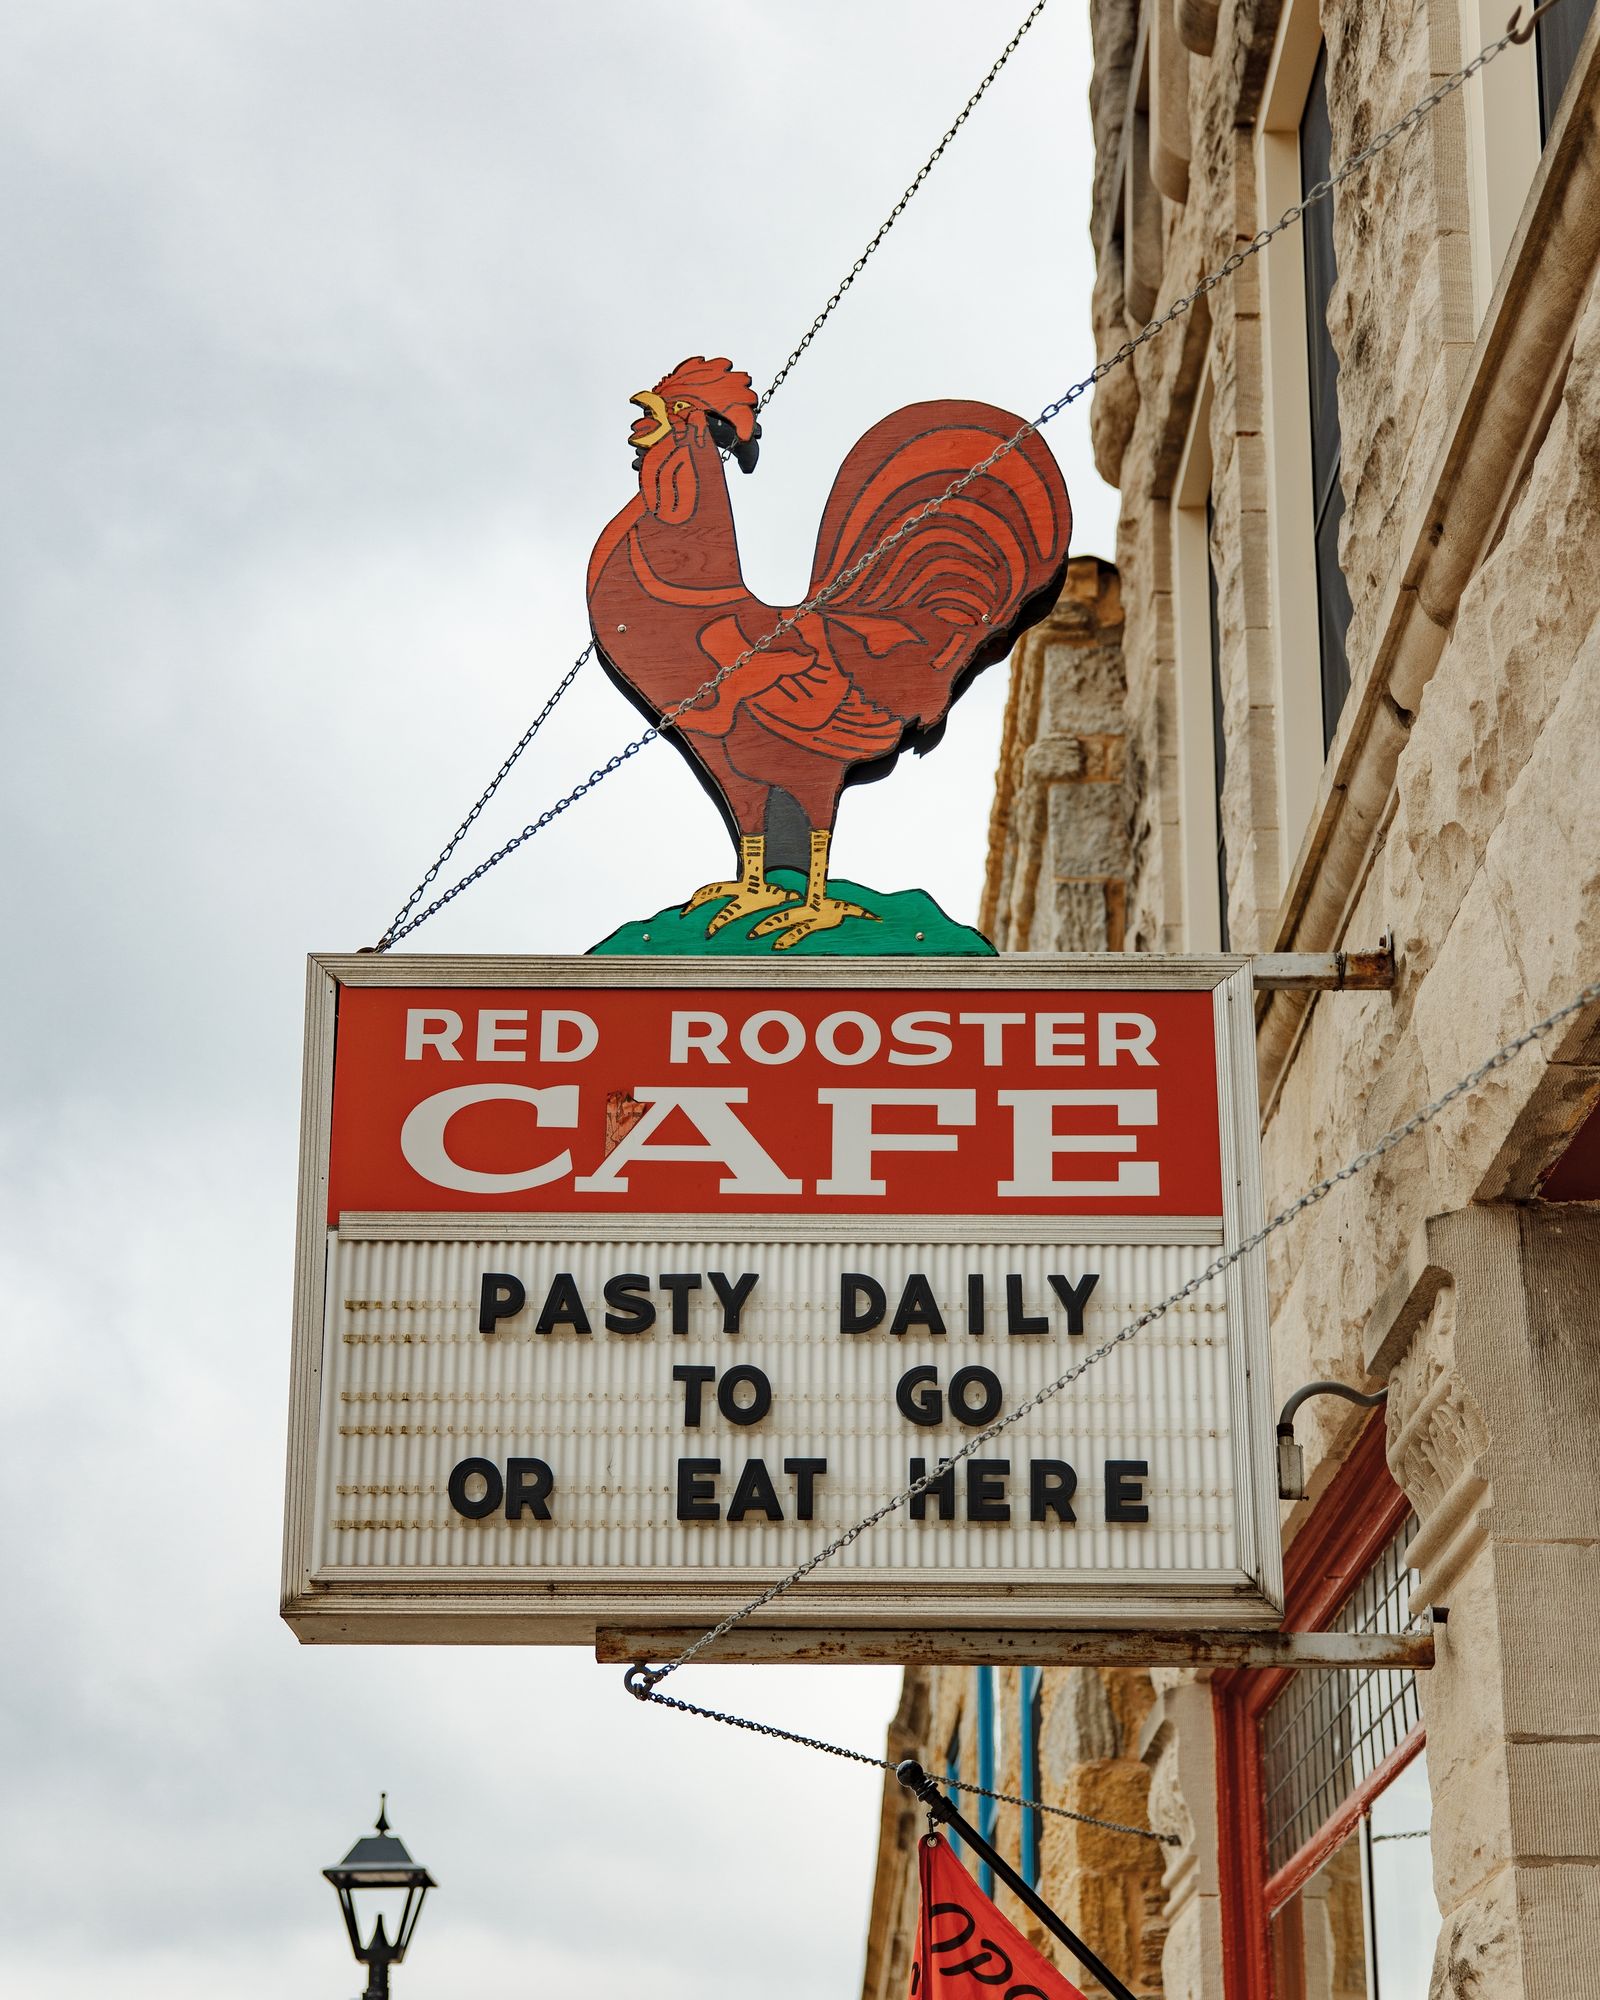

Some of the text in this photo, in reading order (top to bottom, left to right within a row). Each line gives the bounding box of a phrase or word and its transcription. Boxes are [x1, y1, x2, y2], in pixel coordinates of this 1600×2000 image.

[405, 1009, 1159, 1066] RED ROOSTER
[401, 1084, 1159, 1196] CAFE
[479, 1272, 1099, 1336] PASTY DAILY
[673, 1365, 1002, 1427] TO GO
[448, 1458, 1148, 1522] OR EAT HERE
